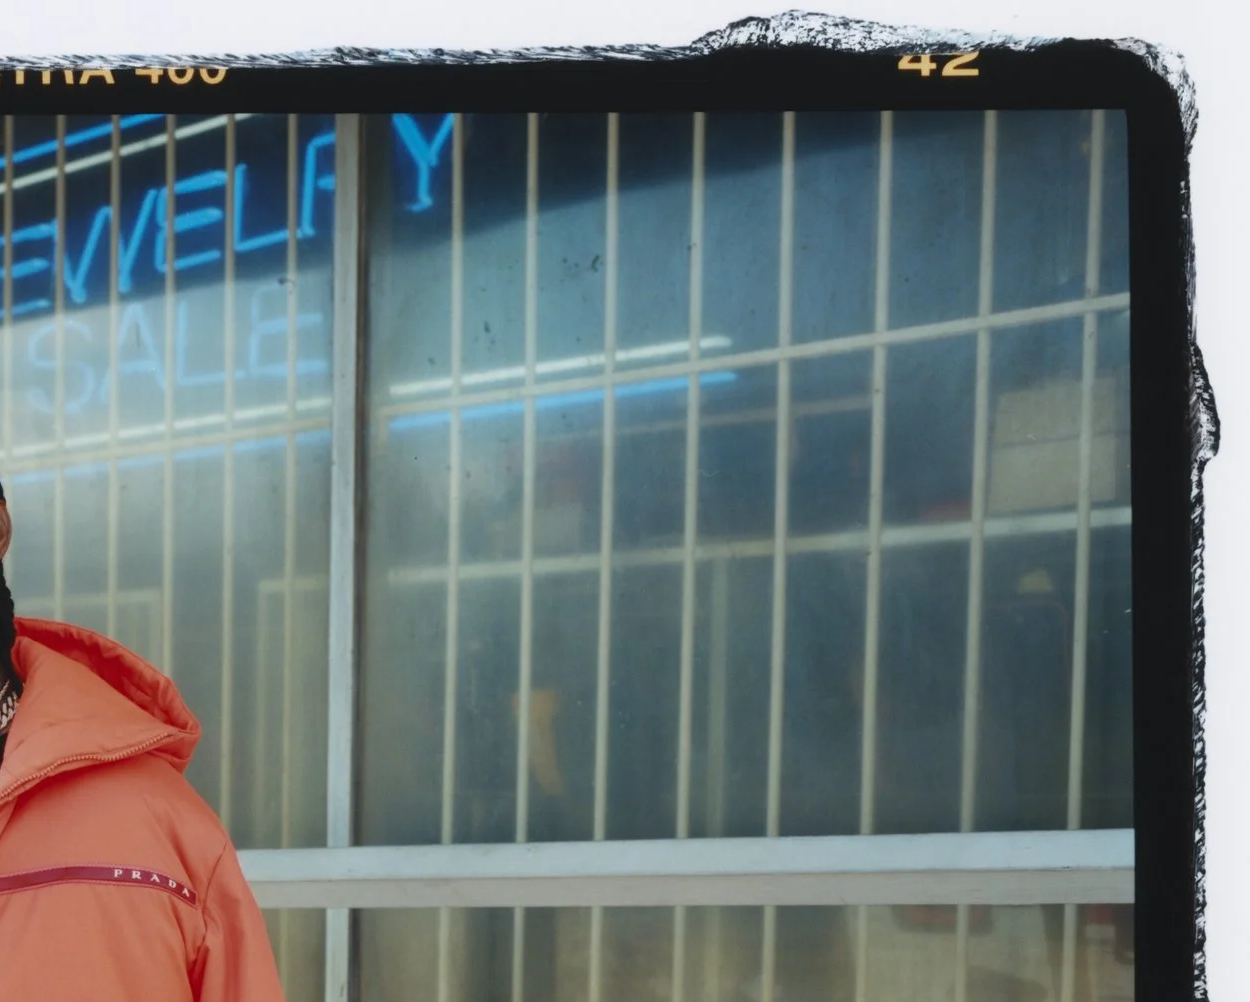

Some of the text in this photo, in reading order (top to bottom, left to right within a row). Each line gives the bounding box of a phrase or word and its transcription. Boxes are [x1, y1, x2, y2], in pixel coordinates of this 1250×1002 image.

[897, 51, 980, 76] 42
[24, 286, 328, 415] SALE
[113, 868, 190, 898] PRADA
